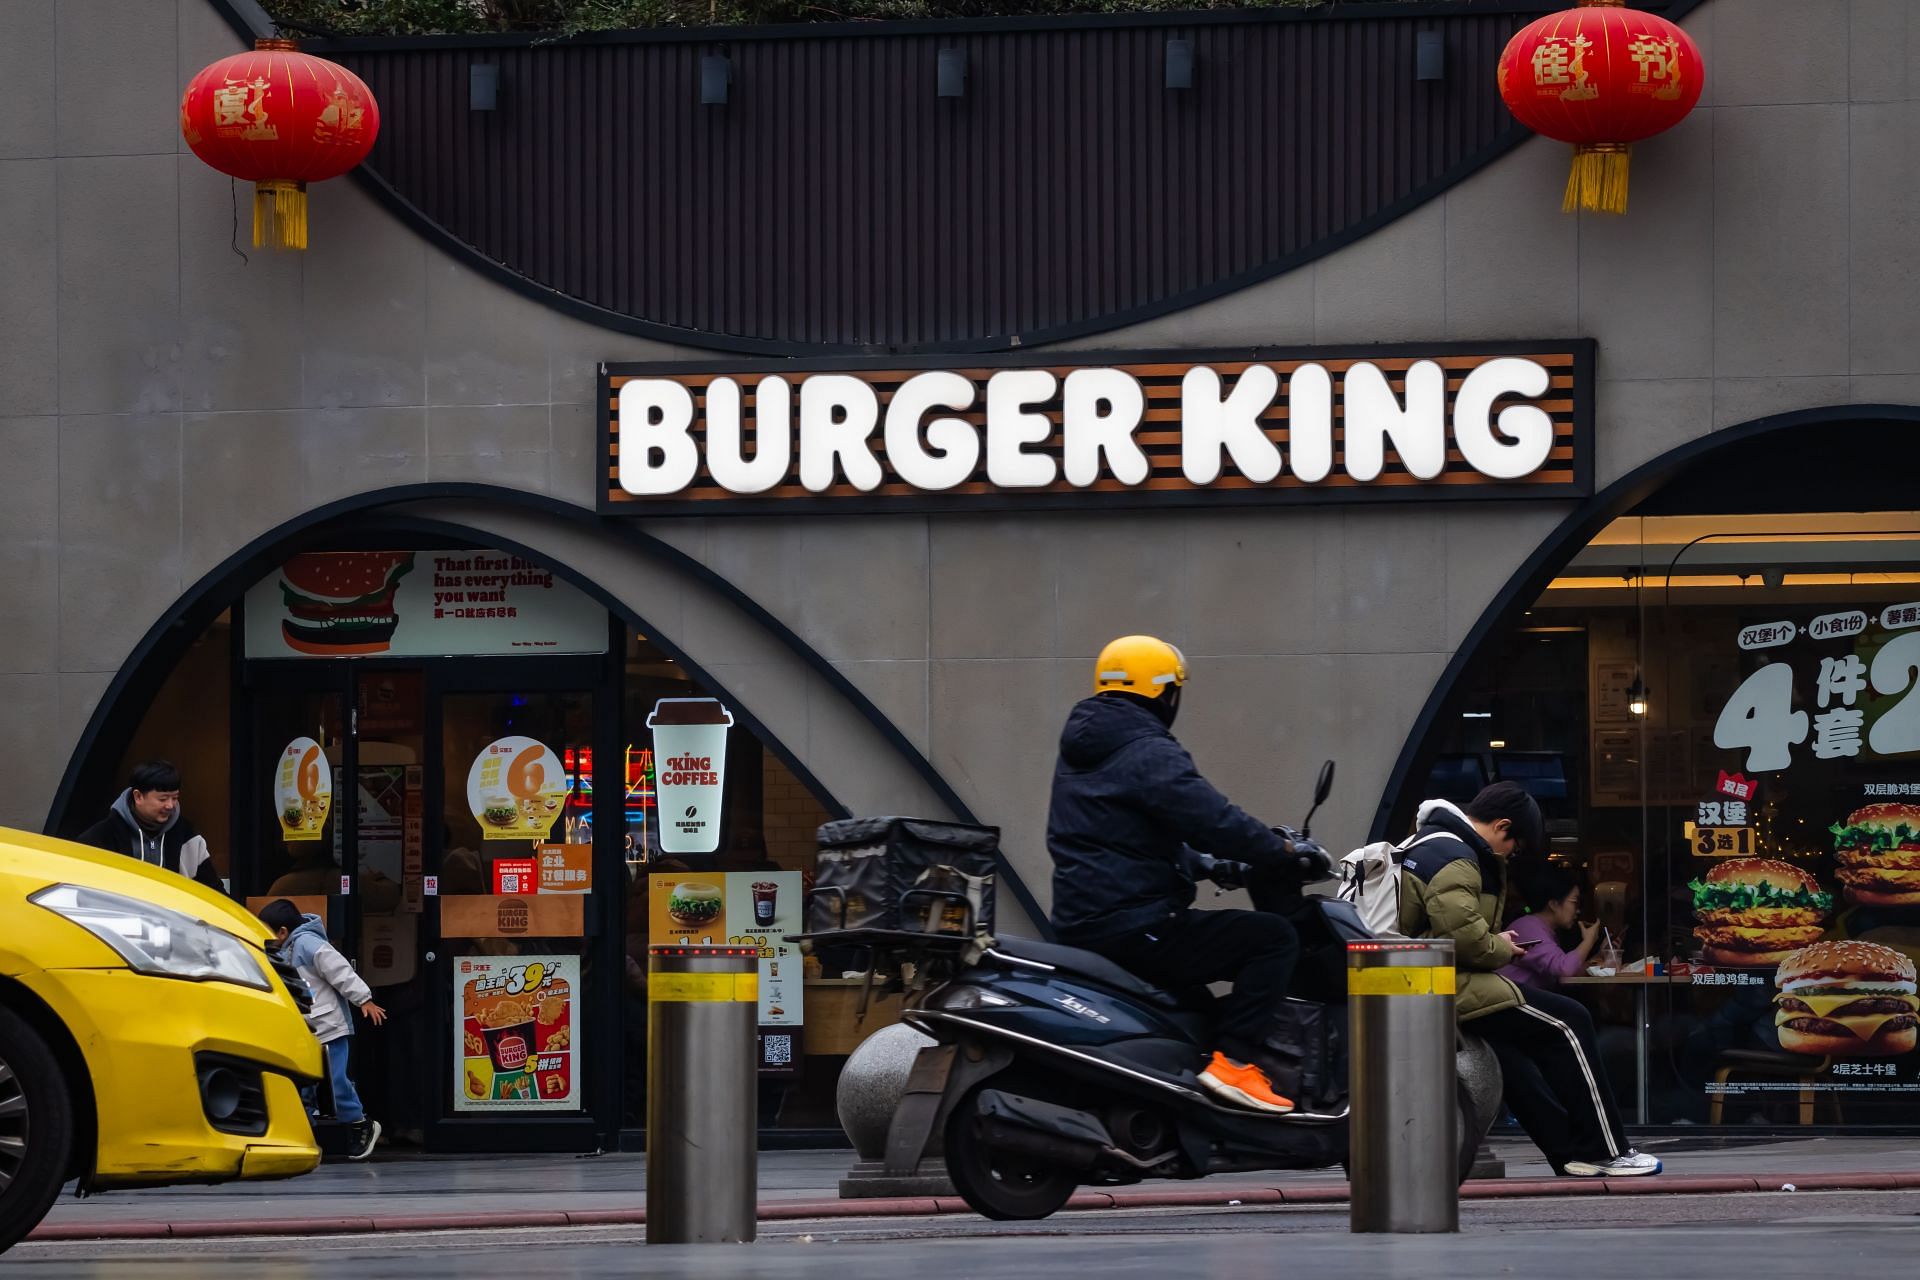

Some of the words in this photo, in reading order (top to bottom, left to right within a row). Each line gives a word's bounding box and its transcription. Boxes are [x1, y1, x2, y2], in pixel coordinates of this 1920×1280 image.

[1530, 43, 1570, 86] 佳
[1628, 40, 1667, 83] 节
[618, 367, 1150, 496] BURGER
[1181, 357, 1557, 486] KING
[434, 557, 471, 571] That
[474, 556, 509, 570] first
[434, 573, 462, 587] has
[464, 570, 553, 589] everything
[434, 592, 464, 606] you
[467, 590, 505, 602] want
[1713, 662, 1809, 773] 4
[666, 756, 711, 771] KING
[661, 772, 718, 786] COFFEE
[1698, 800, 1747, 826] 汉堡
[1697, 829, 1750, 854] 3选1
[498, 909, 529, 917] BURGER
[498, 917, 529, 927] KING
[500, 1044, 525, 1055] BURGER
[502, 1051, 527, 1063] KING
[1832, 1063, 1897, 1076] 2层芝士牛堡
